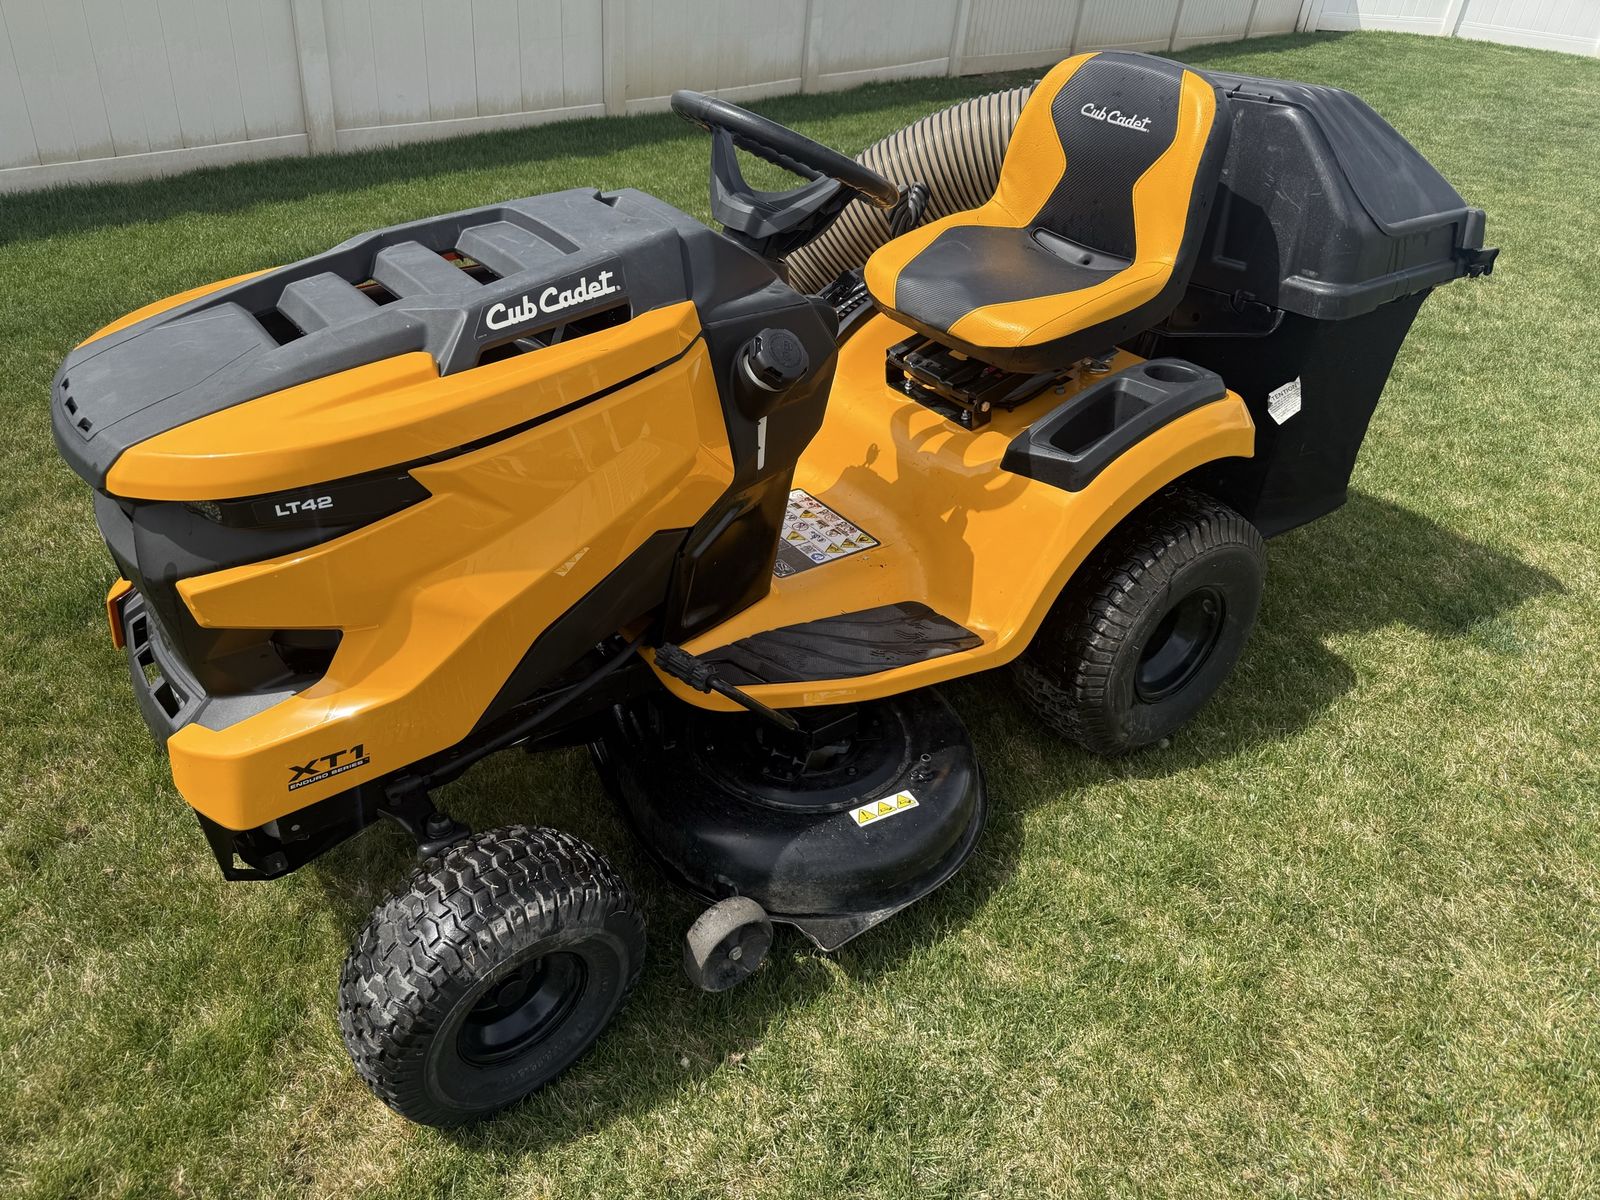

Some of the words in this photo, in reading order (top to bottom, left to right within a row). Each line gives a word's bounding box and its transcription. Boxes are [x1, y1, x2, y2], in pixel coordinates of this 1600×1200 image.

[1080, 103, 1107, 121] Cub
[1107, 110, 1152, 132] Cadet
[485, 295, 538, 331] Cub
[539, 270, 617, 314] Cadet
[1270, 381, 1299, 401] TENTION
[274, 495, 334, 517] LT42
[288, 743, 364, 783] XT1
[289, 772, 329, 790] ENDURO
[331, 760, 364, 775] SERIES
